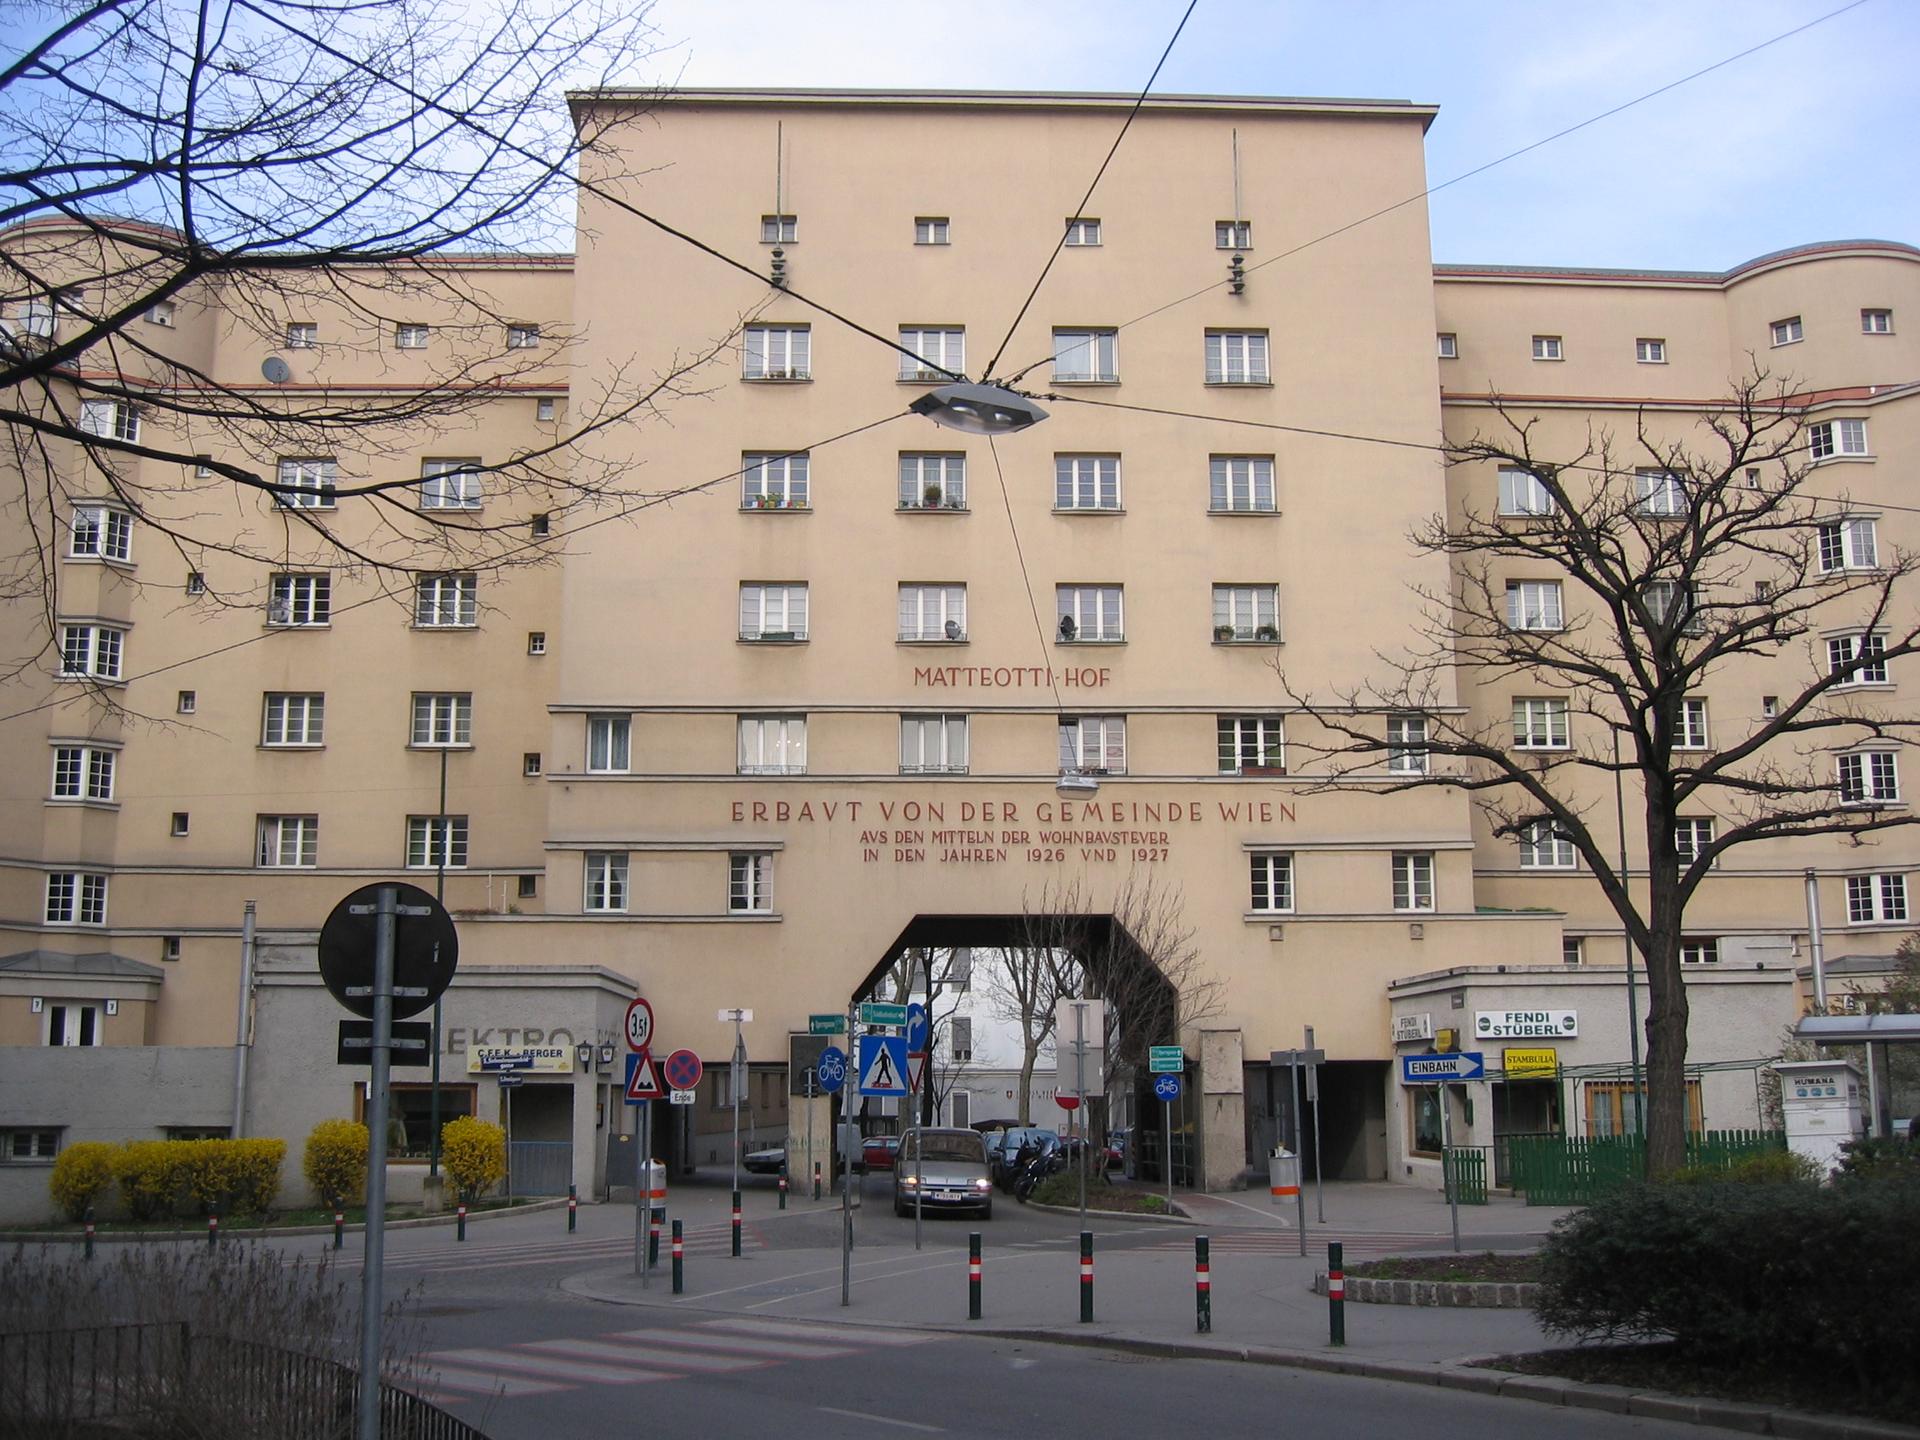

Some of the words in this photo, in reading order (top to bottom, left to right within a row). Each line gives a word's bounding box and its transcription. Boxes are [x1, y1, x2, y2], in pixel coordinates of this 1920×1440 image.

[731, 801, 862, 822] ERBAVT
[879, 801, 944, 822] VON
[961, 802, 1019, 822] DER
[1036, 802, 1203, 822] GEMEINDE
[1218, 802, 1297, 822] WIEN
[859, 830, 888, 844] AVS
[895, 830, 924, 844] DEN
[931, 831, 994, 844] MITTELN
[1001, 831, 1030, 844] DER
[1039, 831, 1170, 845] WOHNBAVSTEVER
[863, 848, 878, 862] IN
[895, 848, 924, 862] DEN
[940, 848, 1007, 862] JAHREN
[1027, 848, 1065, 862] 1926
[1081, 848, 1116, 862] VND
[1132, 848, 1169, 862] 1927
[1505, 1012, 1550, 1023] FENDI
[1493, 1023, 1563, 1036] STÜBERL
[522, 1048, 563, 1058] BERGER
[1412, 1061, 1457, 1073] EINBAHN
[1794, 1077, 1835, 1085] HUMANA
